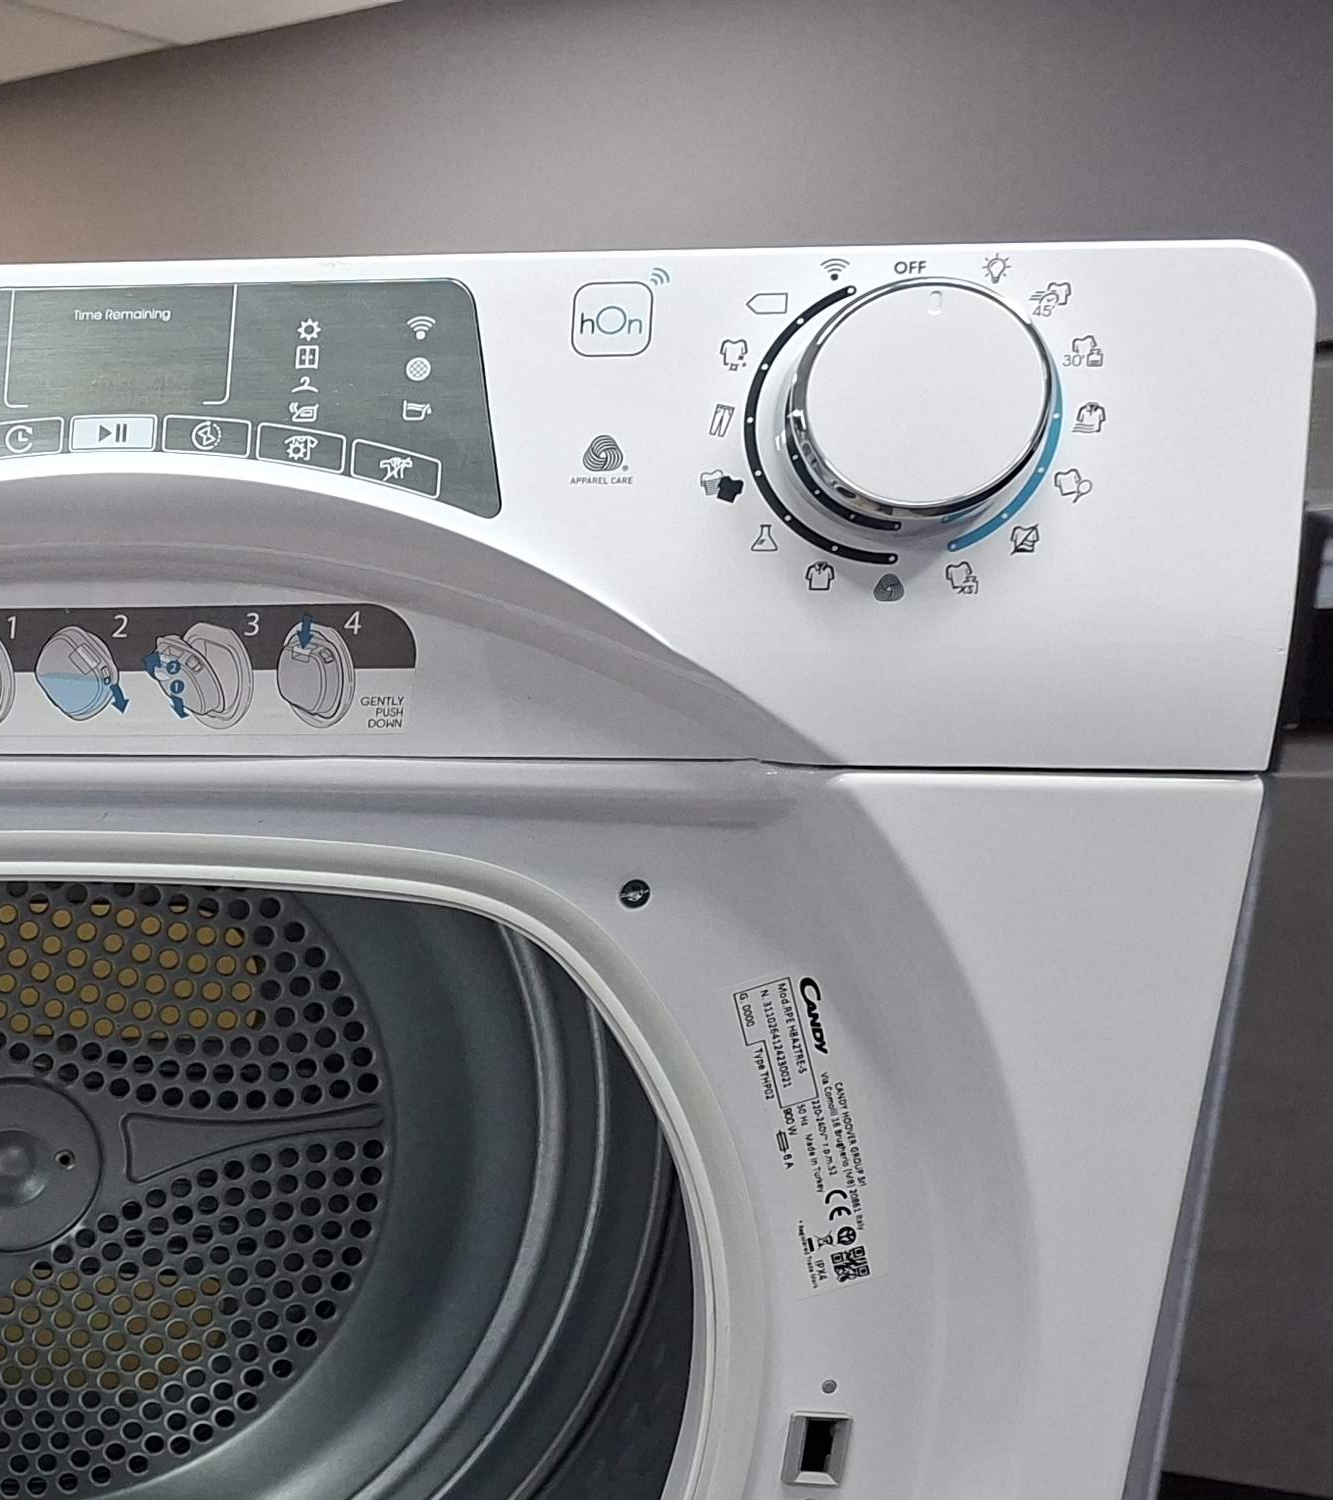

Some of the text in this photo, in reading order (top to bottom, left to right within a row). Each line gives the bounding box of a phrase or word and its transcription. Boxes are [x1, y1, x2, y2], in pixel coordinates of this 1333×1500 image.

[893, 260, 927, 275] OFF
[74, 308, 171, 322] Time Remaining
[580, 306, 642, 335] hOn
[570, 476, 634, 485] APPAREL CARE
[7, 616, 18, 639] 1
[111, 615, 129, 639] 2
[244, 613, 260, 637] 3
[344, 615, 362, 635] 4
[360, 696, 405, 706] GENTLY
[376, 707, 404, 717] PUSH
[368, 718, 403, 729] DOWN
[741, 1004, 755, 1028] 0000
[799, 976, 829, 1056] CANDY
[751, 1047, 774, 1100] Type THP02
[819, 1071, 830, 1084] Via
[796, 1103, 806, 1114] 50
[787, 1125, 797, 1136] W
[834, 1081, 848, 1110] CANDY
[841, 1111, 857, 1145] HOOVER
[849, 1146, 864, 1175] GROUP
[804, 1133, 816, 1156] Made
[811, 1166, 825, 1193] Turkey
[814, 1259, 827, 1280] IPX4
